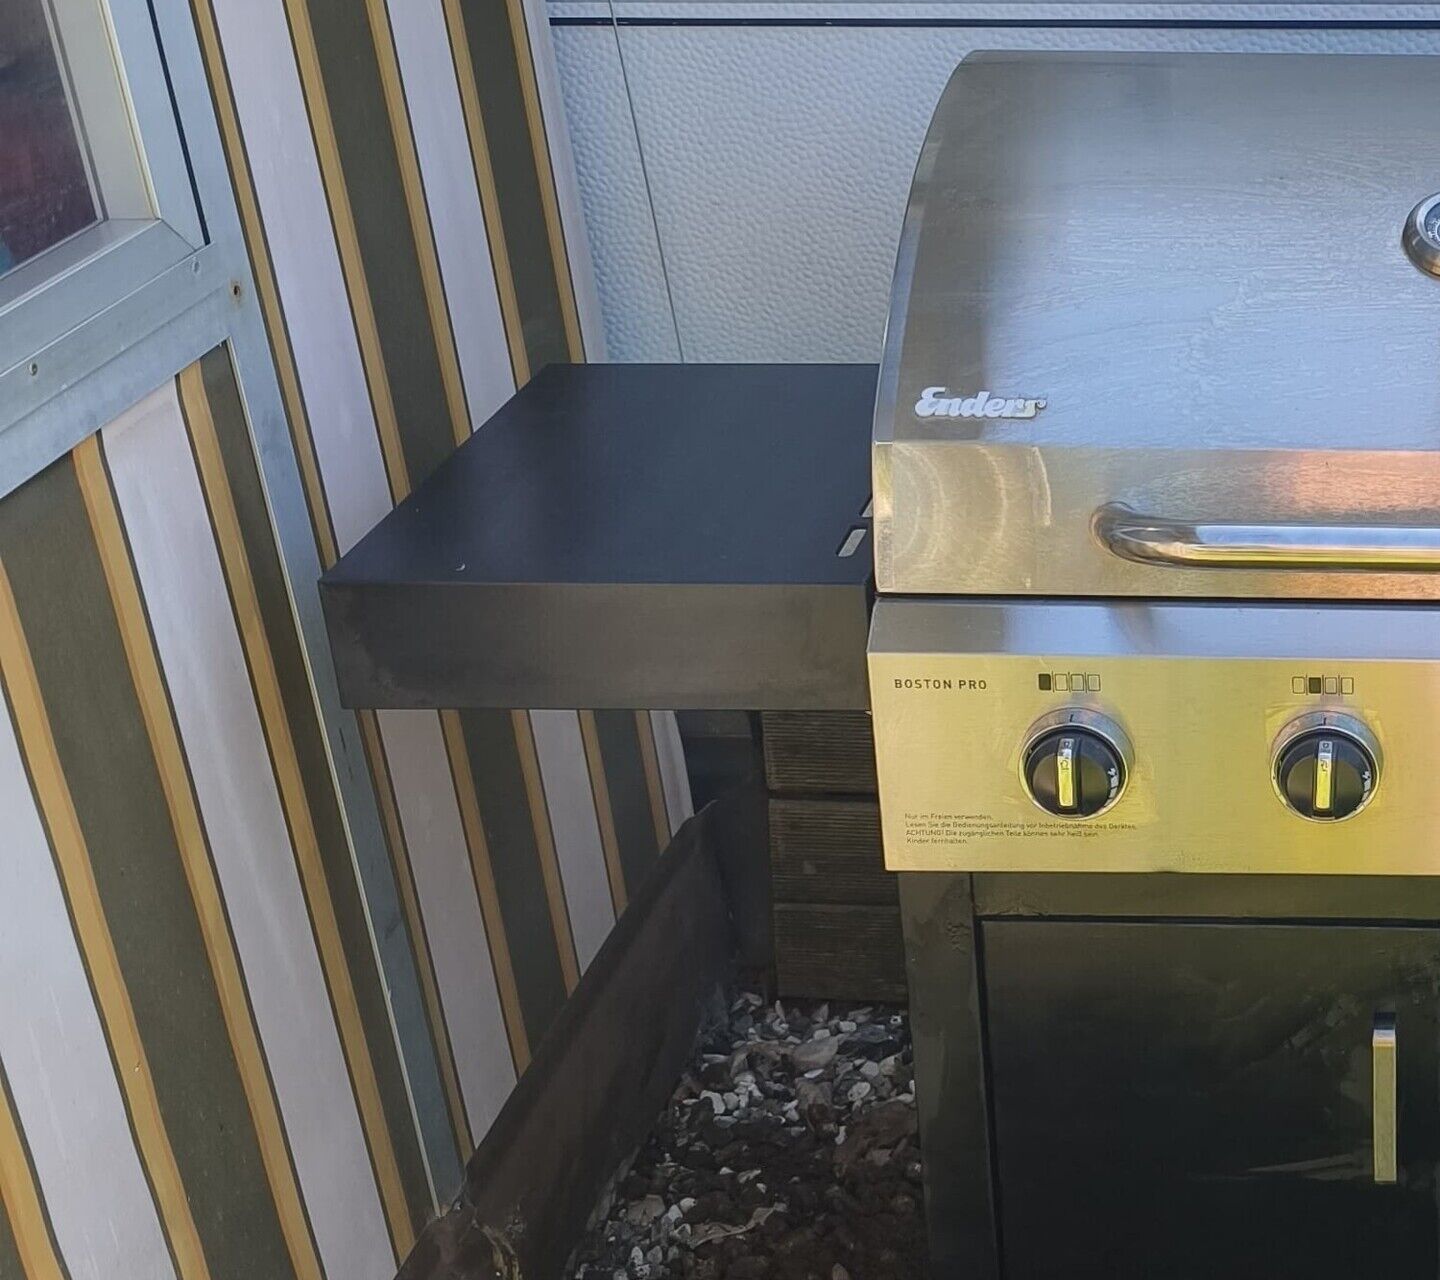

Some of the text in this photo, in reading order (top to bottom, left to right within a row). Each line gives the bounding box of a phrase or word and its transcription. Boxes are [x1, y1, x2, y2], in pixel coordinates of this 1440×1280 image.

[914, 386, 1038, 418] Enders
[894, 679, 987, 690] BOSTON PRO
